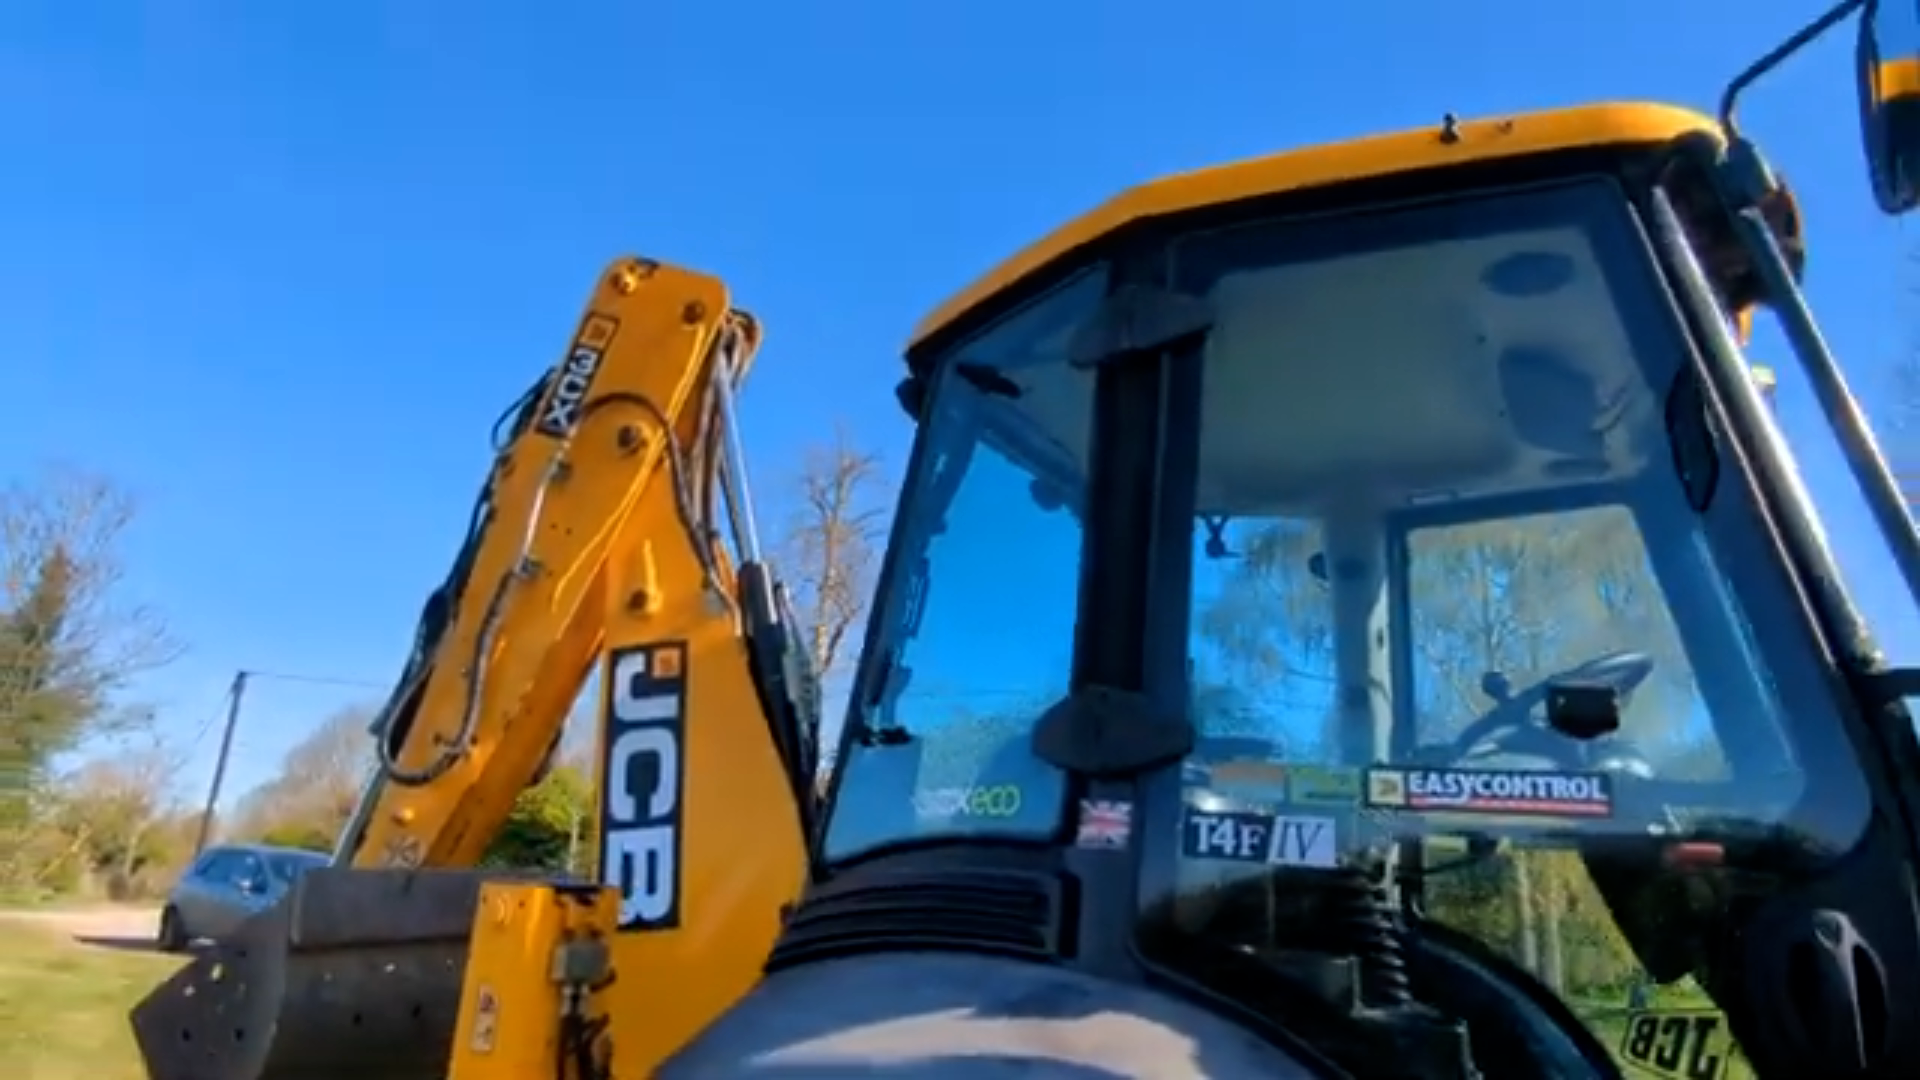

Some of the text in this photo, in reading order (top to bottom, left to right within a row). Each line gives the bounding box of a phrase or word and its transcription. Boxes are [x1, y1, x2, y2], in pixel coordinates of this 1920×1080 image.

[606, 649, 680, 925] JCB
[1408, 770, 1609, 804] EASYCONTROL
[1189, 815, 1325, 861] T4F IV
